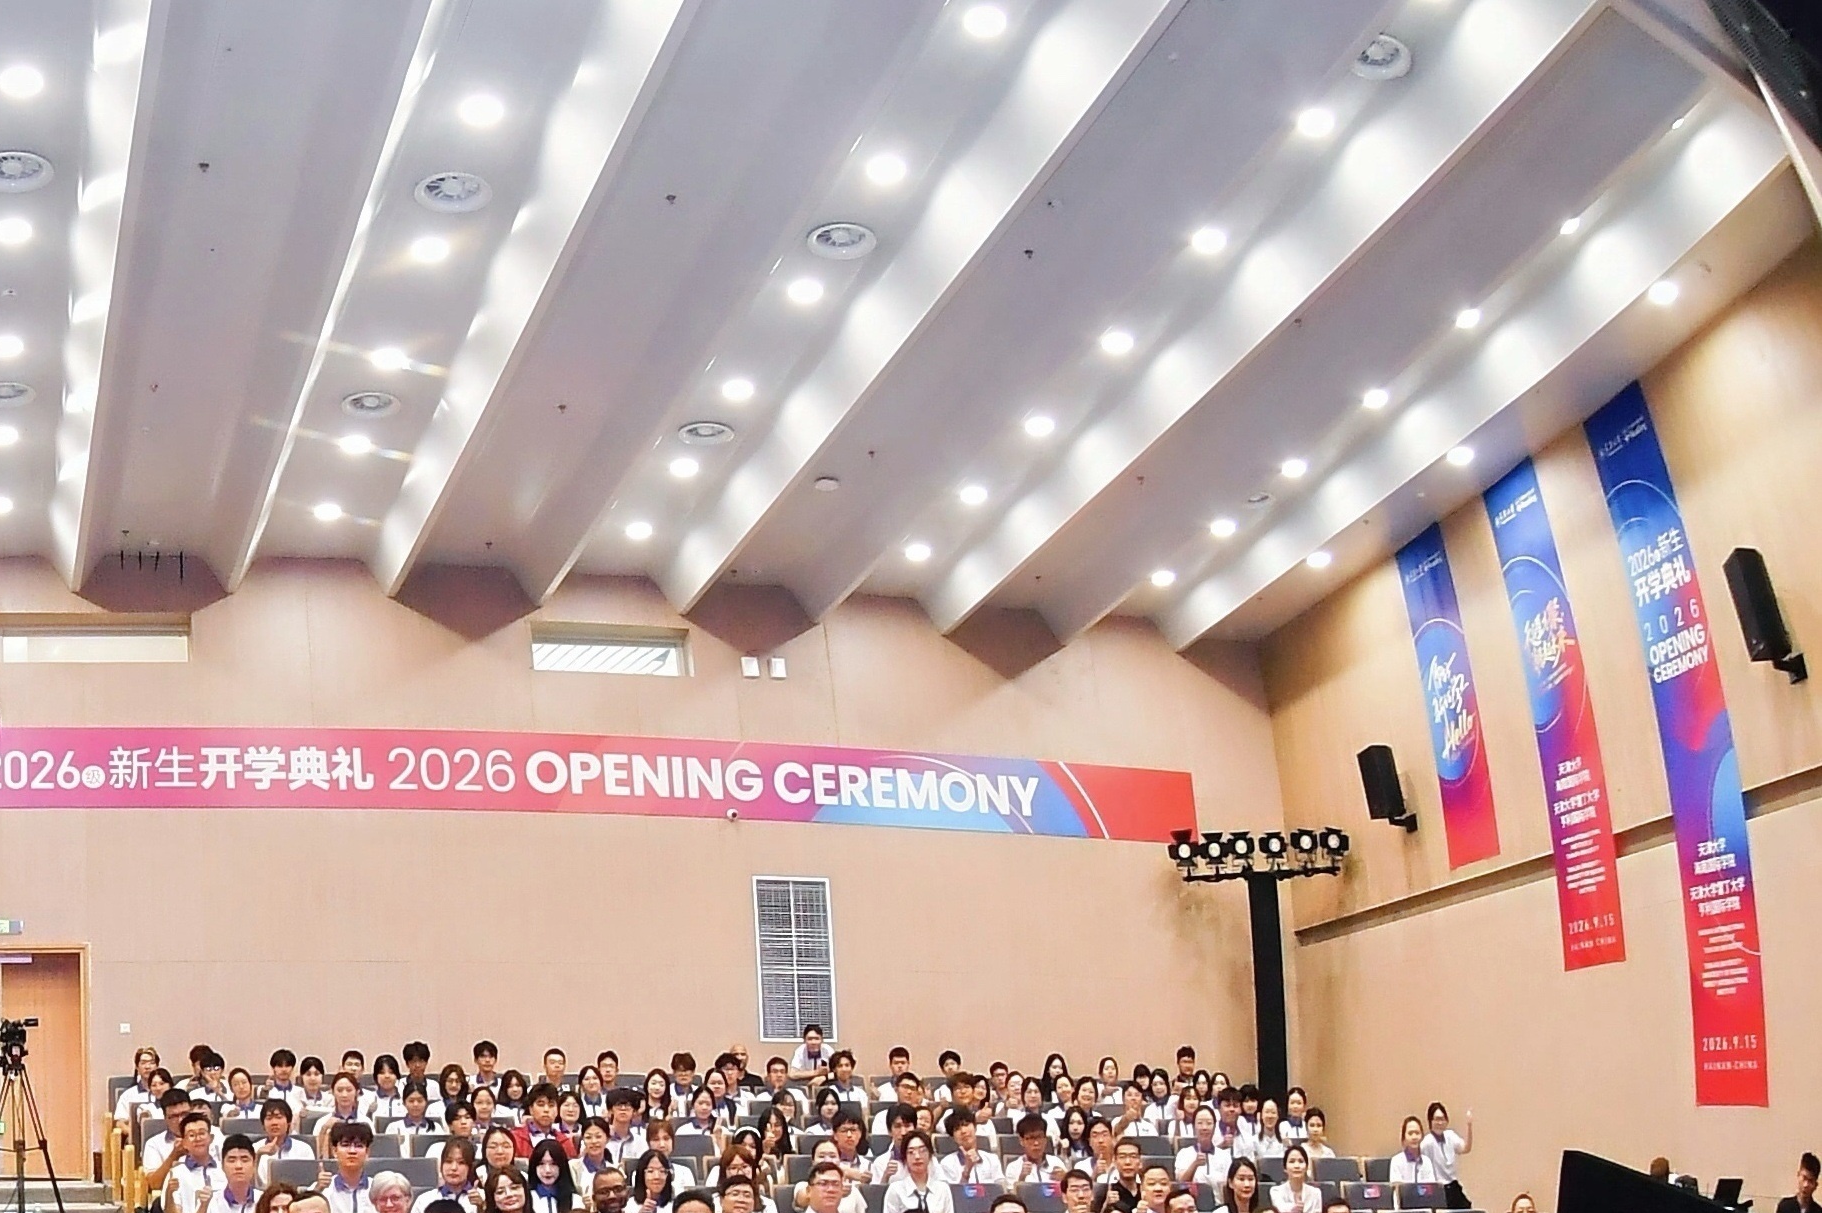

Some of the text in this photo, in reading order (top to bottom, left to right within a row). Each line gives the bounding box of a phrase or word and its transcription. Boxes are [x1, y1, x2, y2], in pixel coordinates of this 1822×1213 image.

[1634, 554, 1691, 607] 开学典礼
[1649, 623, 1705, 665] OPENING
[1653, 645, 1709, 684] CEREMONY
[1442, 709, 1476, 759] Hello
[387, 747, 517, 793] 2026
[525, 751, 764, 801] OPENING
[773, 761, 1039, 816] CEREMONY
[1568, 913, 1615, 936] 2026.9.15
[1702, 1034, 1757, 1052] 2026.9.15
